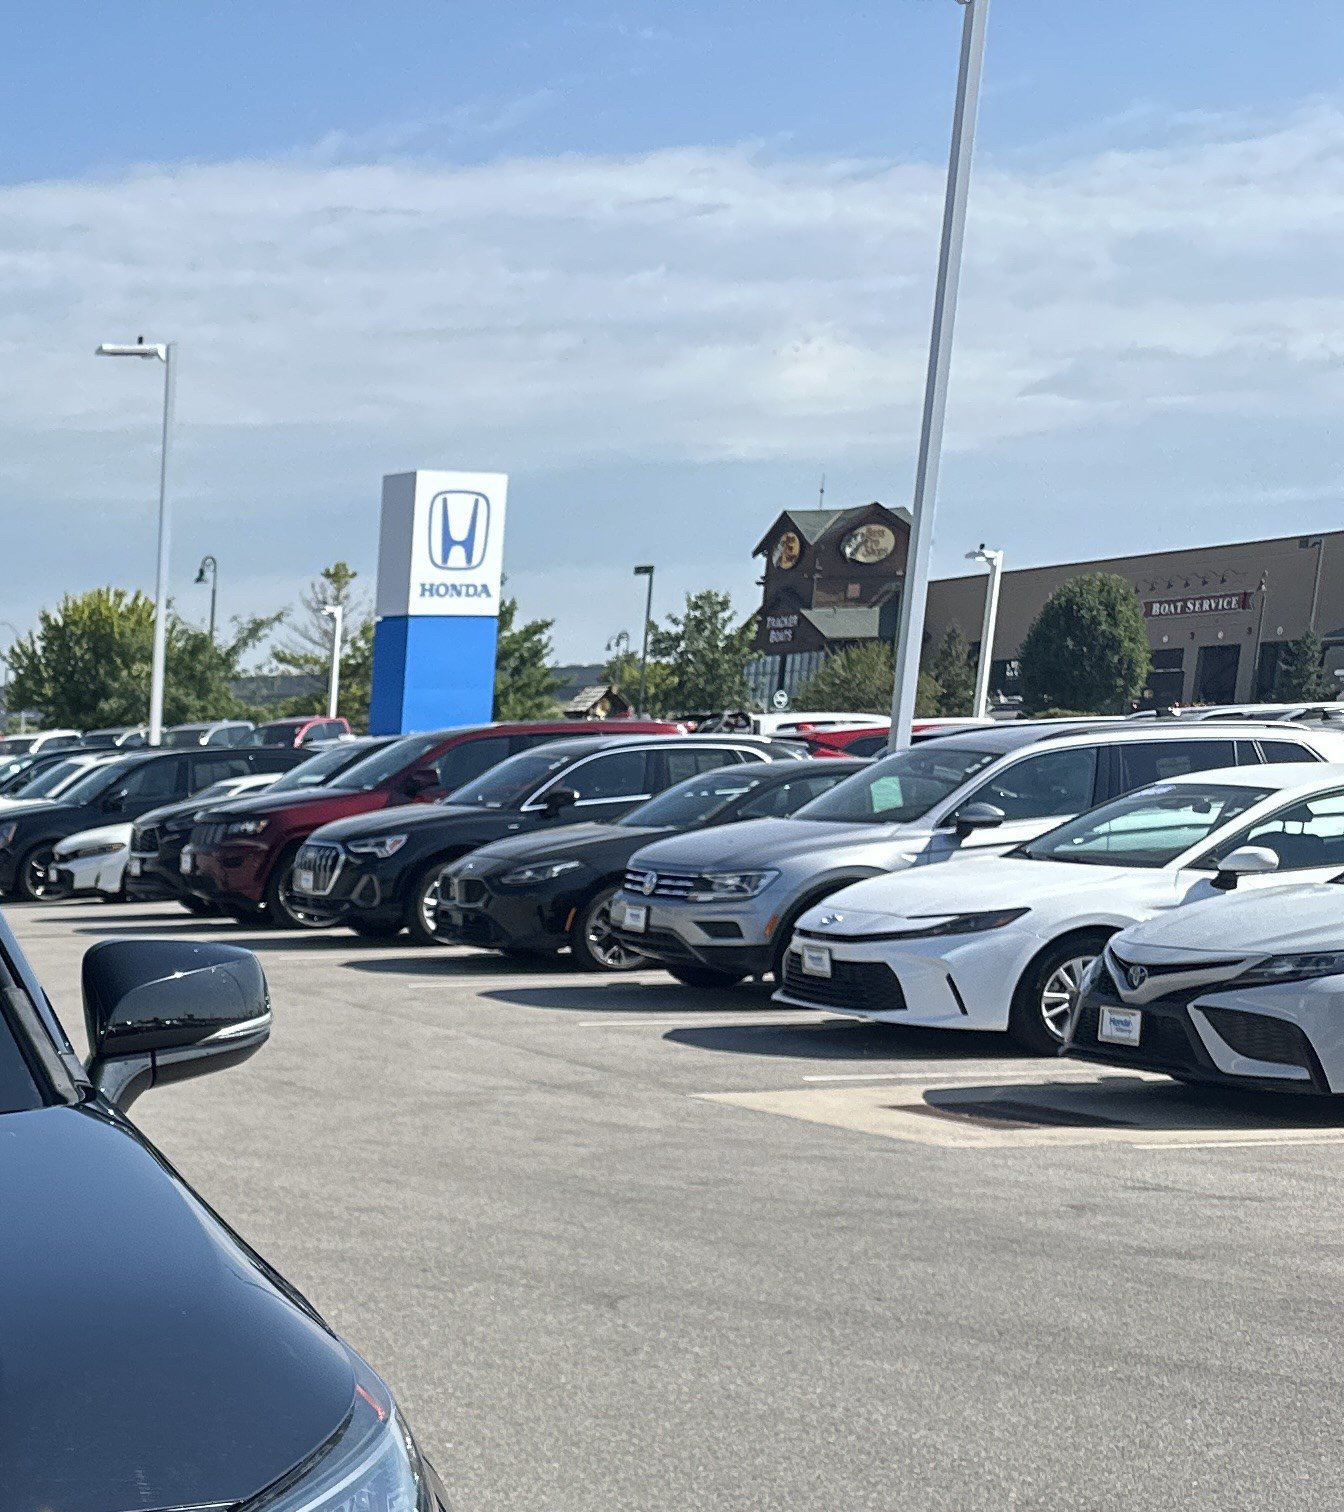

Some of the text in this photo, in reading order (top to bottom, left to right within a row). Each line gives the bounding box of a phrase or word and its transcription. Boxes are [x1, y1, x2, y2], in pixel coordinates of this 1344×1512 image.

[419, 583, 491, 598] HONDA
[1152, 597, 1239, 615] BOAT SERVICE
